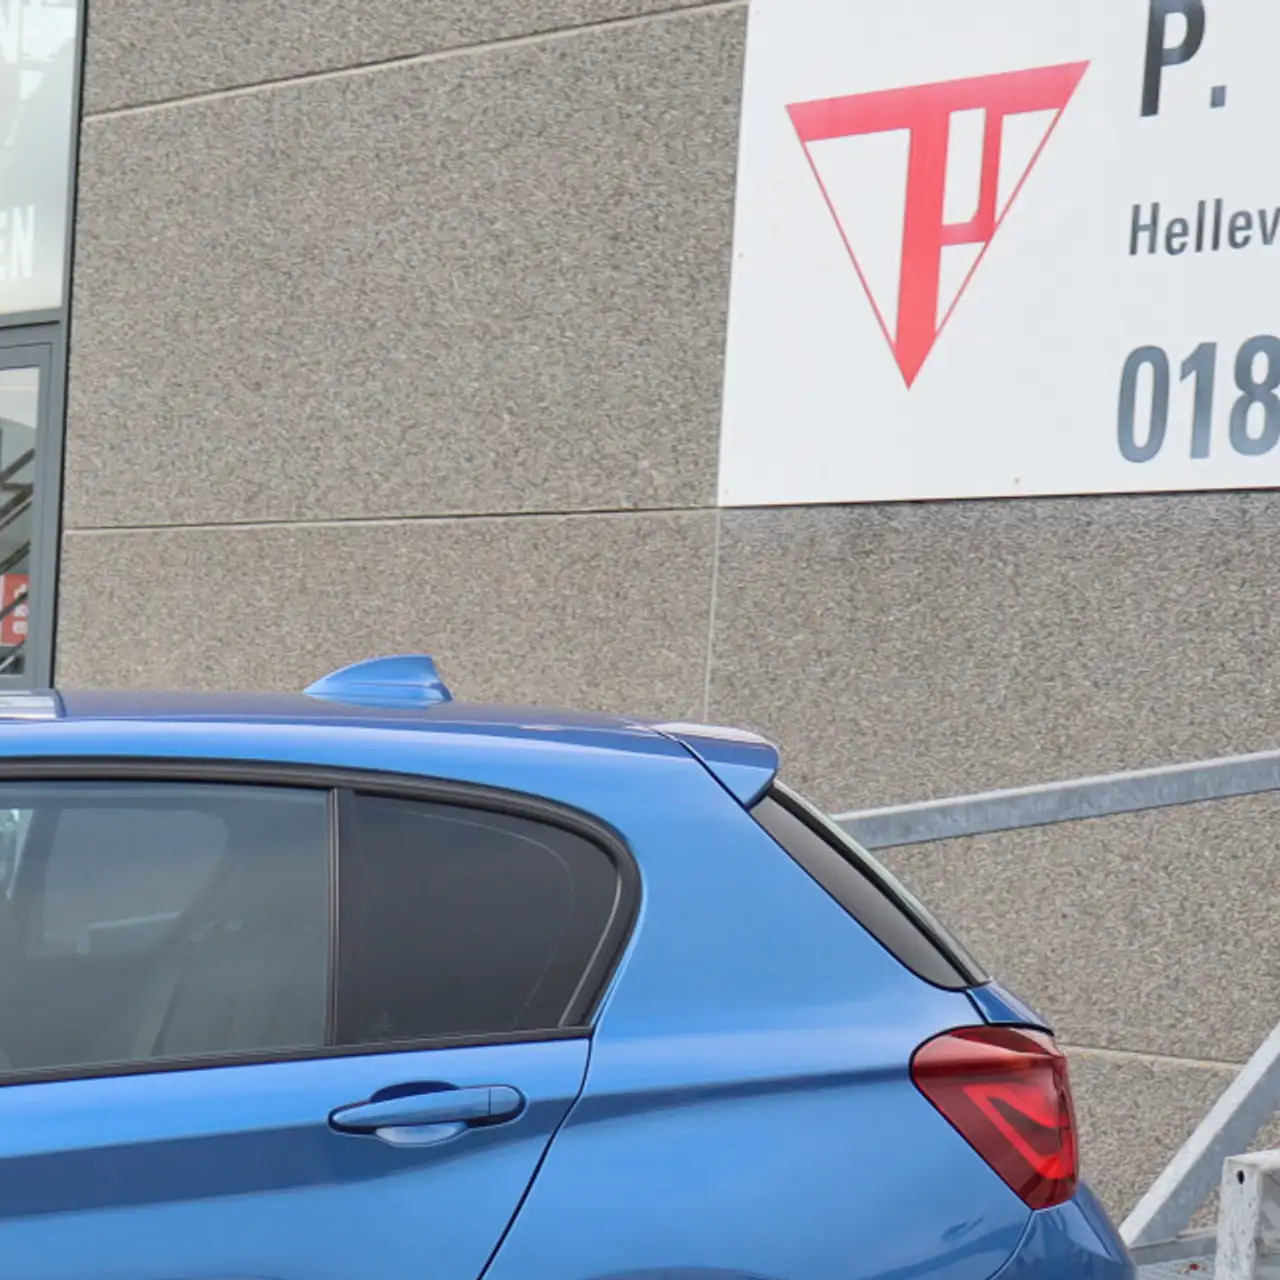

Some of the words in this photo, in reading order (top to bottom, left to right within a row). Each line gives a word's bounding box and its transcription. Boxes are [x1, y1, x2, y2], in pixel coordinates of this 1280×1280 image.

[1140, 0, 1226, 117] P.
[1128, 198, 1280, 256] Hellev
[1116, 334, 1280, 464] 018
